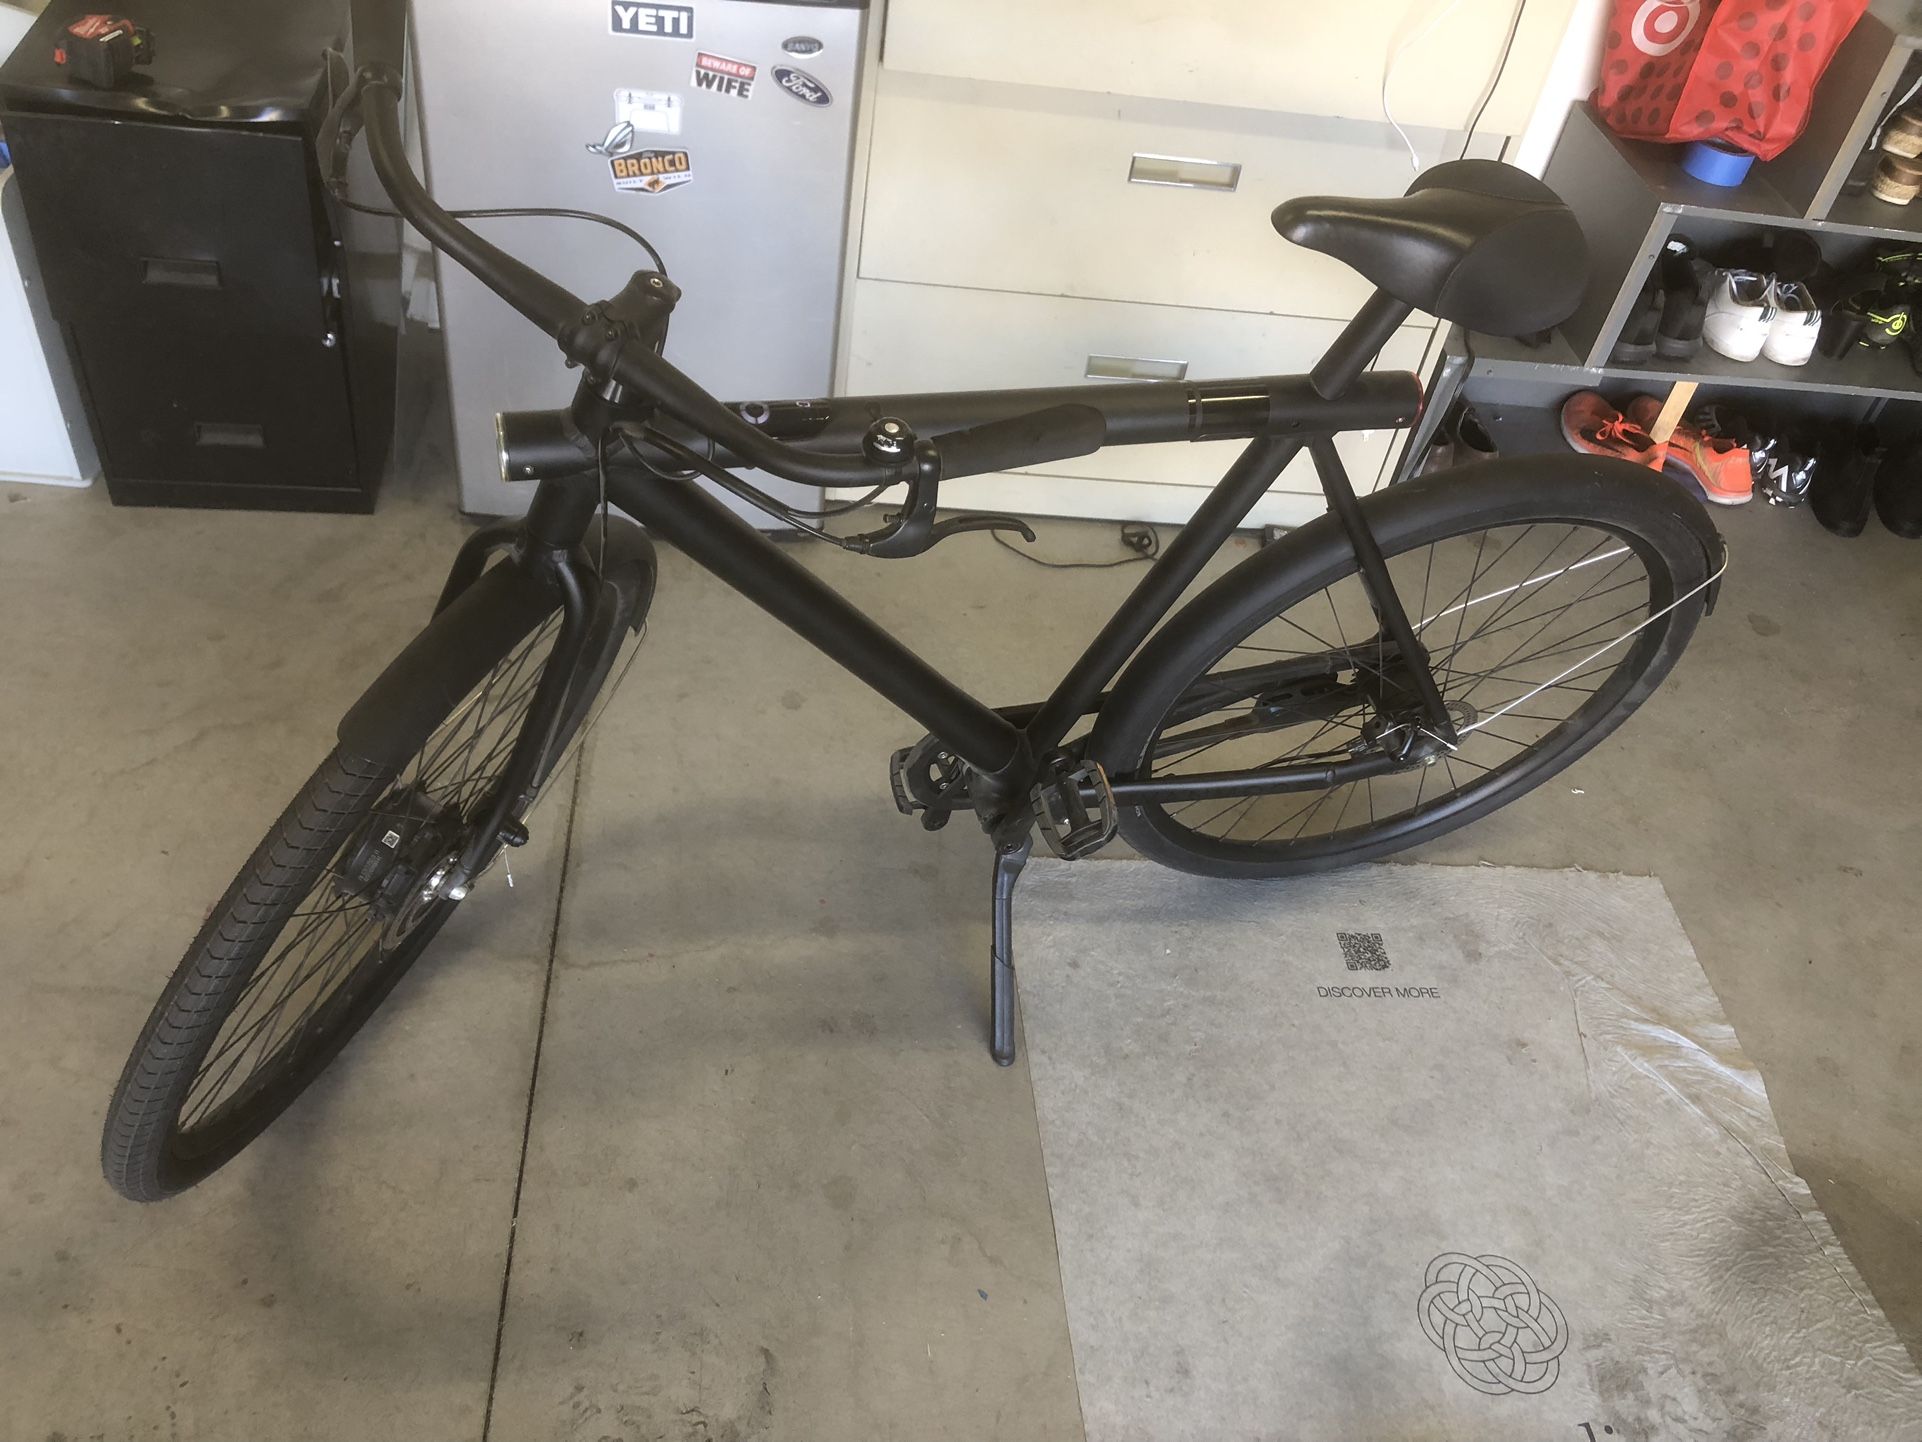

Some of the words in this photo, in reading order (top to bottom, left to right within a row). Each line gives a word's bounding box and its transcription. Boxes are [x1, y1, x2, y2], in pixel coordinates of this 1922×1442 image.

[613, 5, 689, 34] YETI
[701, 55, 738, 73] BEWARE
[738, 65, 753, 76] OF
[695, 69, 752, 99] WIFE
[781, 72, 823, 102] Ford
[613, 152, 688, 178] BRONCO
[1316, 986, 1394, 999] DISCOVER
[1394, 987, 1441, 999] MORE
